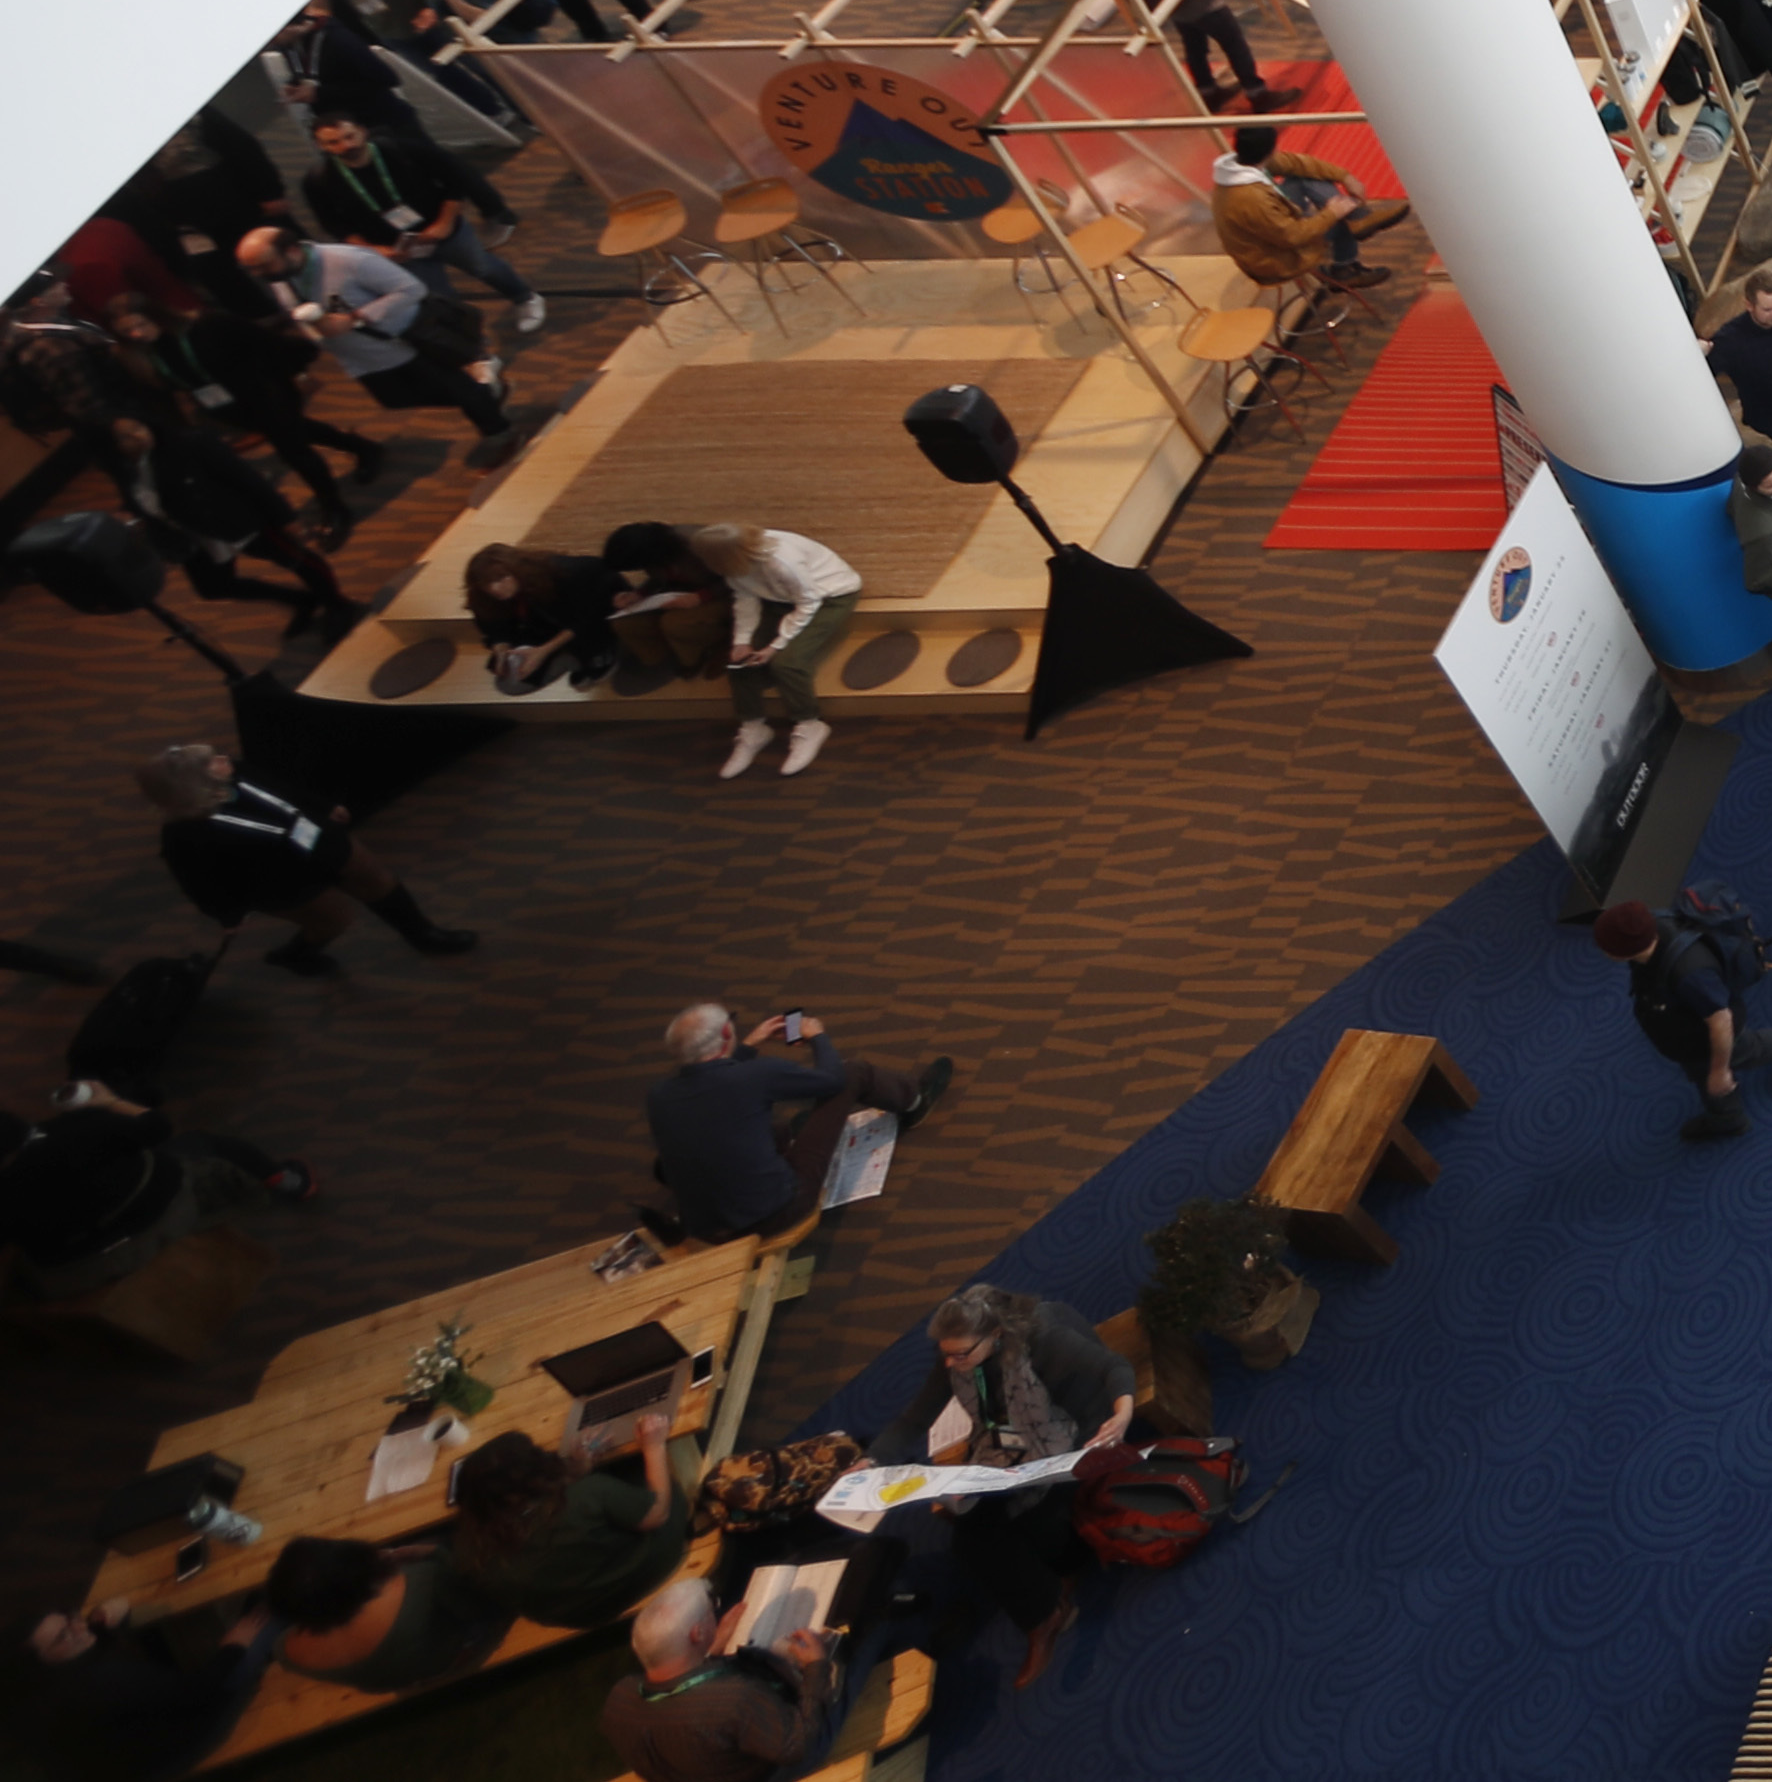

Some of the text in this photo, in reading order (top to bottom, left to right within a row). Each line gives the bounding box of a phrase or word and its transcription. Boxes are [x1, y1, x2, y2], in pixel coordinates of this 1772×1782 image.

[775, 71, 898, 152] VENTURE
[854, 176, 992, 200] STATION
[1616, 762, 1650, 830] OUTDOOR
